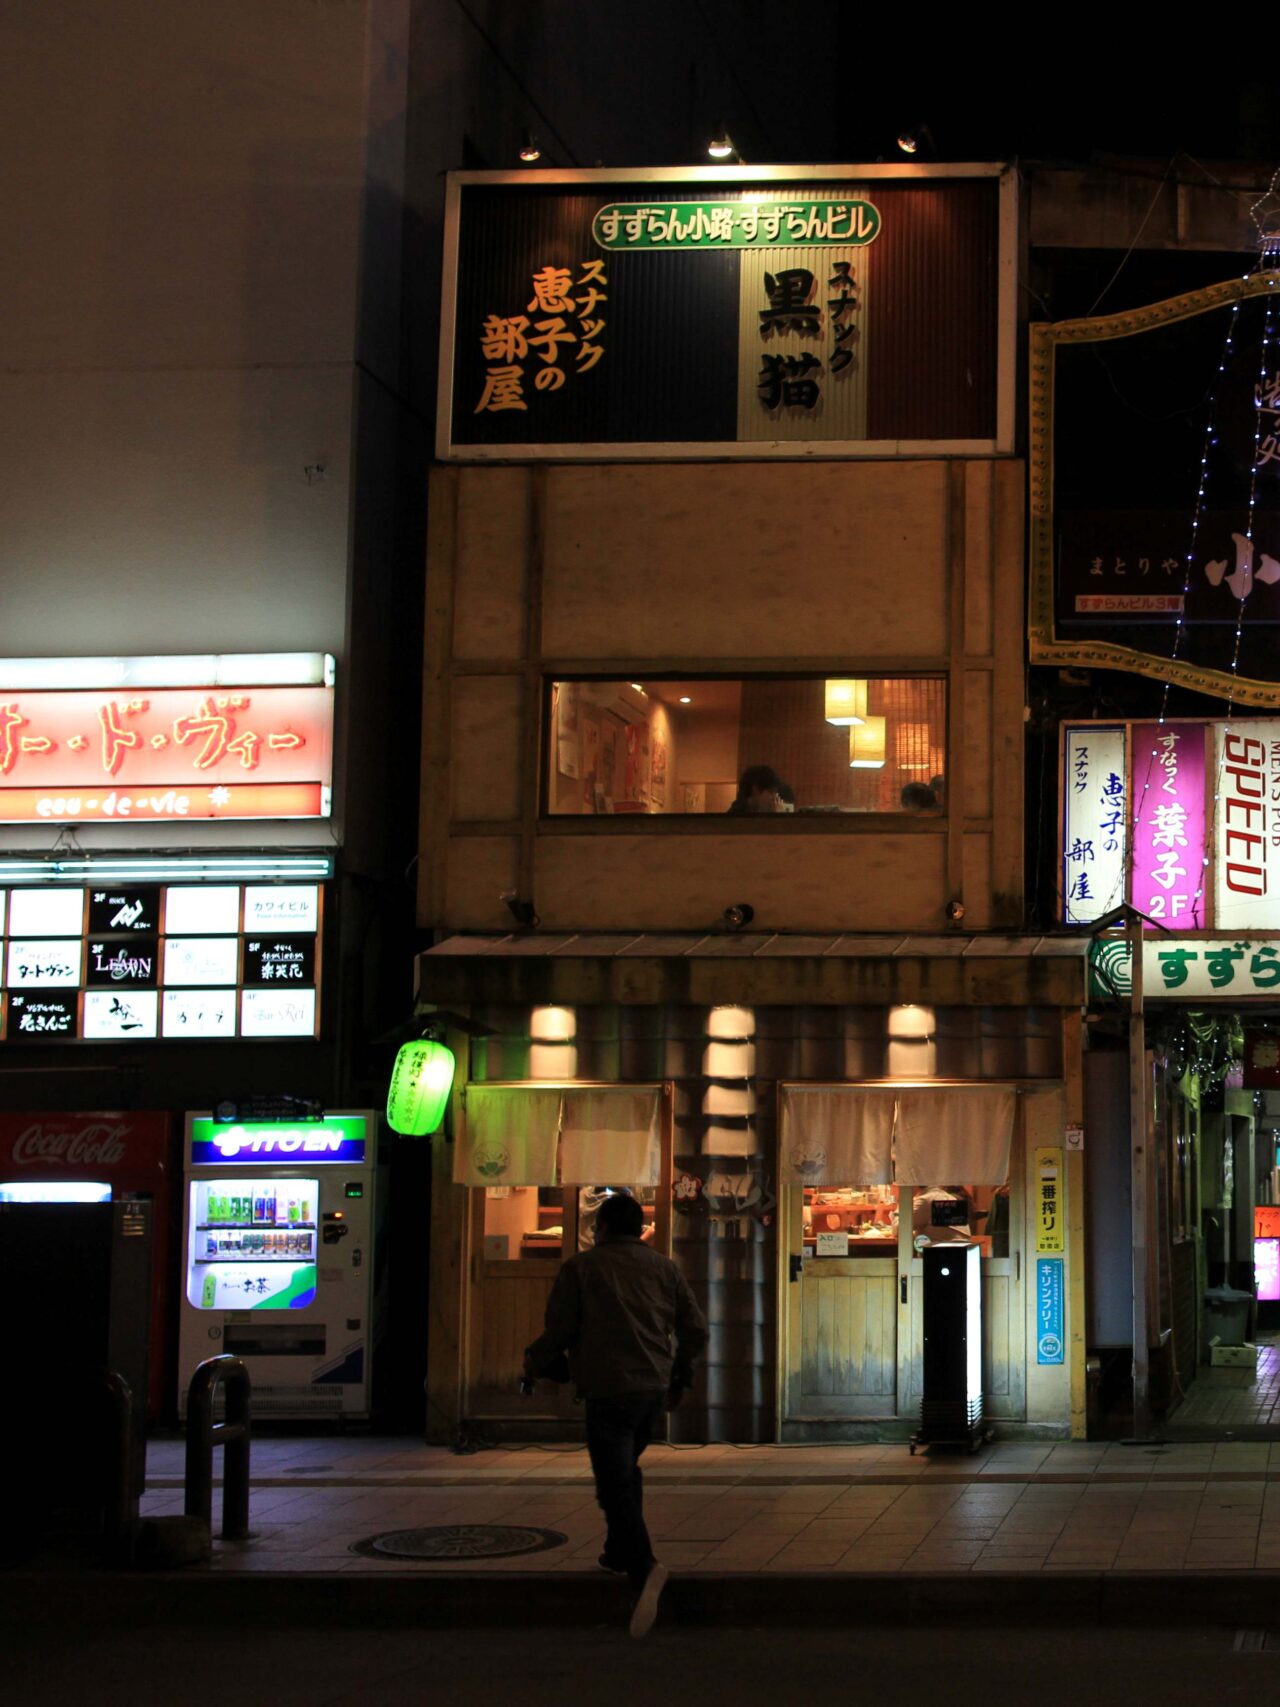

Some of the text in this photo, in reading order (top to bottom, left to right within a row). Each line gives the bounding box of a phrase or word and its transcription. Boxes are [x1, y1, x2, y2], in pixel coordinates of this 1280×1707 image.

[528, 265, 576, 392] 恵子の
[575, 259, 608, 374] スナック
[757, 267, 824, 412] 黒猫
[828, 261, 858, 374] スナック
[474, 314, 532, 414] 部屋
[1089, 557, 1180, 576] まとりや
[1074, 747, 1090, 793] スナック
[1157, 732, 1181, 795] すなっく
[36, 790, 190, 817] eau-de-vie
[1100, 772, 1127, 852] 恵子の
[1225, 733, 1268, 897] SPEED
[1065, 837, 1095, 902] 部屋
[1147, 803, 1189, 891] 葉子
[254, 902, 309, 911] カワイビル
[1149, 895, 1188, 918] 2F
[18, 963, 74, 978] タートヴァン
[1041, 1176, 1057, 1231] 一番搾り
[1041, 1265, 1052, 1329] キリンフリー
